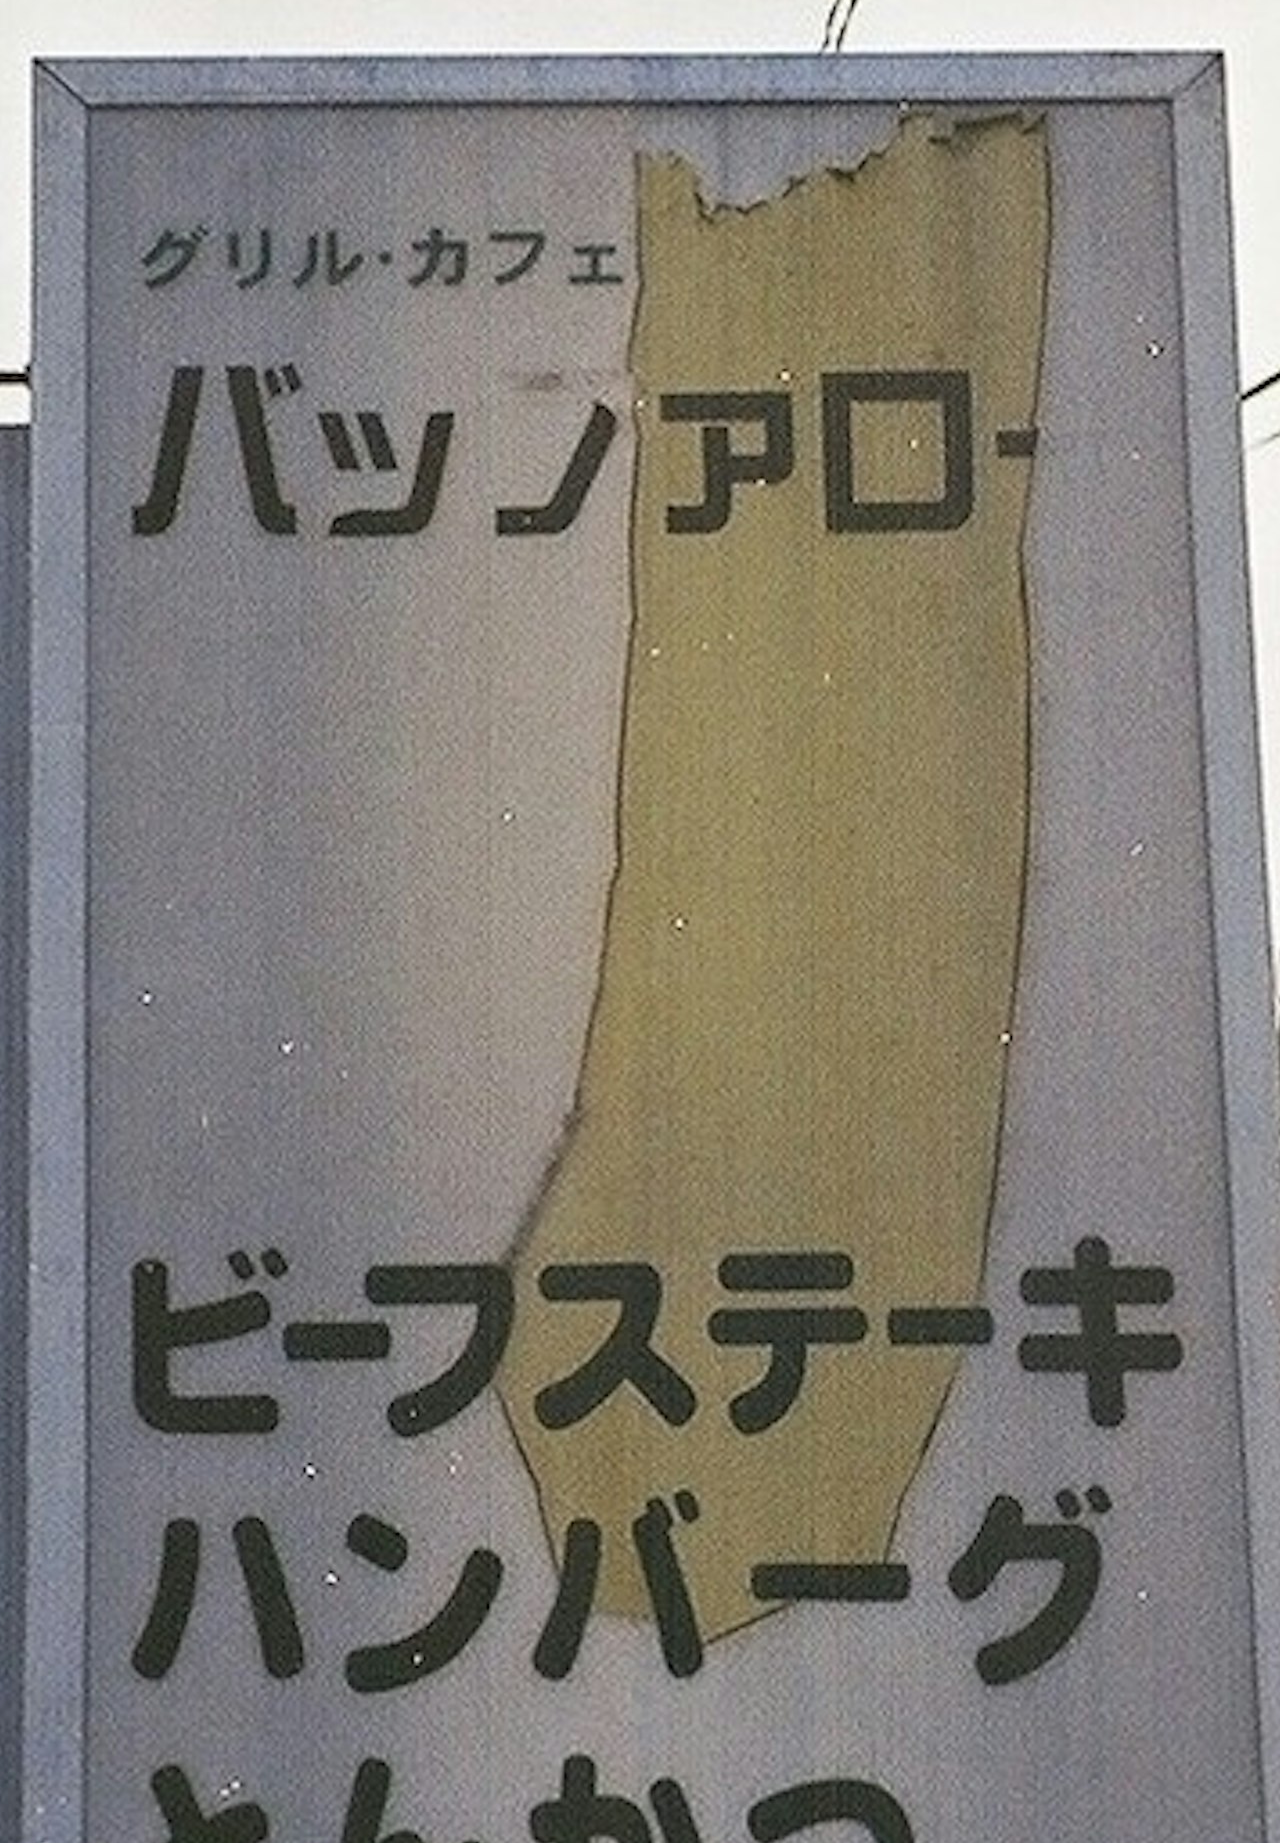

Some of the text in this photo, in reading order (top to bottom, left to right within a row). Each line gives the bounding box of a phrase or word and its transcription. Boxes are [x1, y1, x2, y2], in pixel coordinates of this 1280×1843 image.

[141, 225, 624, 289] グリル・カフェ
[130, 1235, 1184, 1440] ビーフステーキ
[130, 1484, 1114, 1696] ハンバーグ
